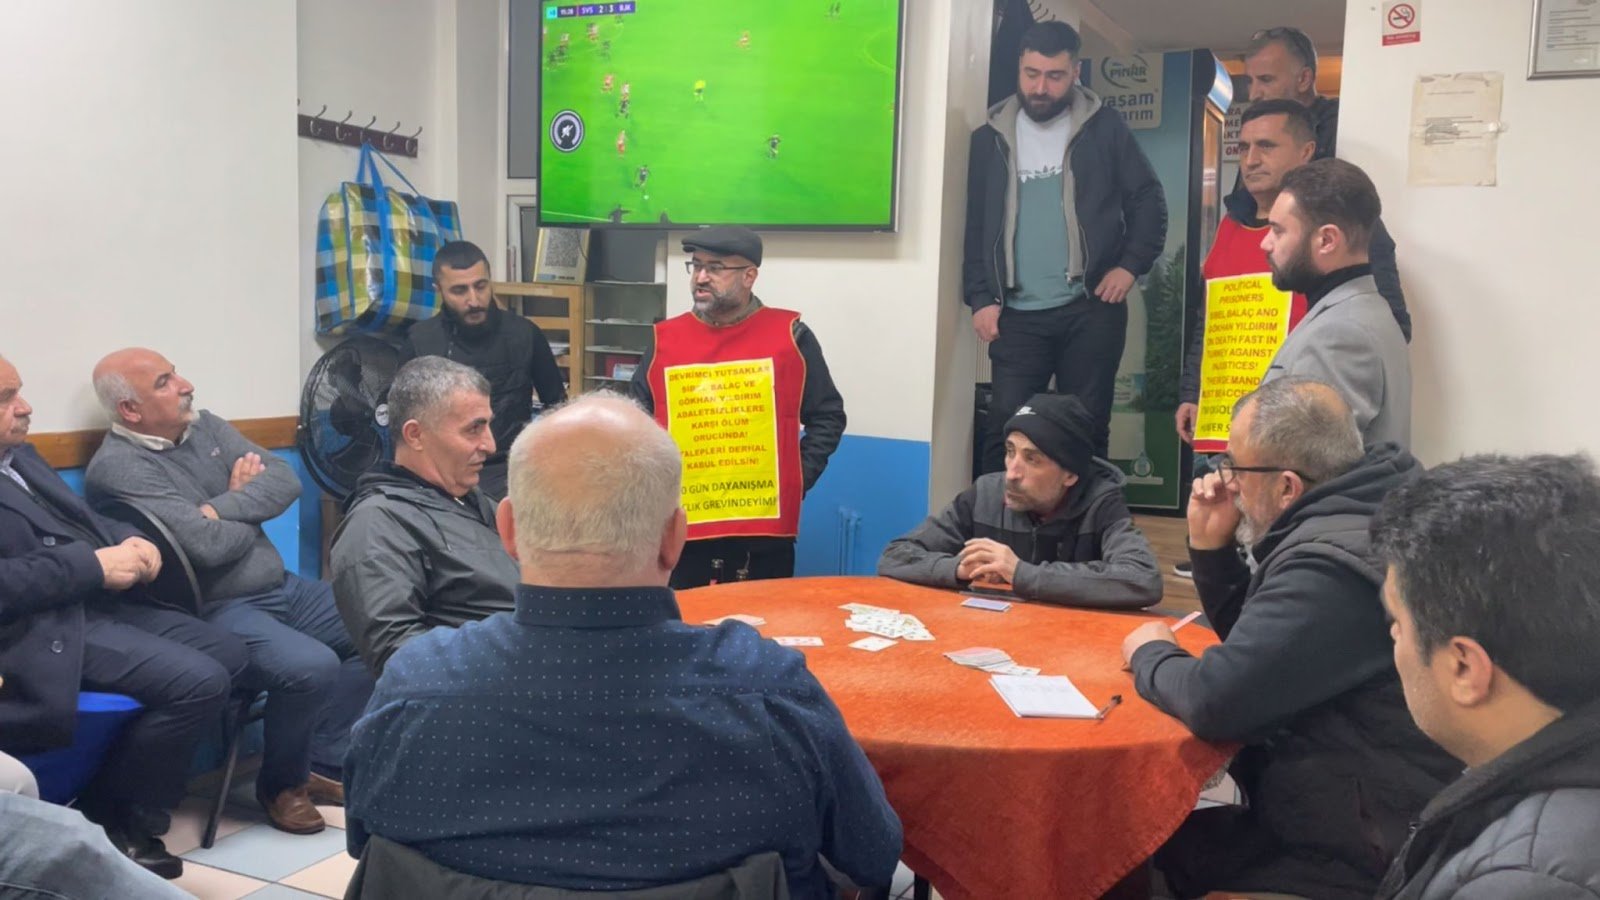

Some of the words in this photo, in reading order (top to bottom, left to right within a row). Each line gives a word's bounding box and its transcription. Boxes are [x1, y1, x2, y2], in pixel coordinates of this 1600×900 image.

[599, 5, 604, 13] 2
[1219, 294, 1264, 304] PRISONERS
[1256, 308, 1278, 317] AND
[1235, 321, 1278, 331] YILDIRIM
[1238, 335, 1264, 344] FAST
[1266, 335, 1278, 344] IN
[1229, 348, 1273, 357] AGAINST
[711, 382, 741, 392] BALAÇ
[679, 396, 716, 406] GÖKHAN
[691, 420, 718, 430] KARŞI
[721, 418, 749, 427] ÖLÜM
[693, 432, 748, 442] ORUCUNDA!
[729, 445, 766, 453] DERHAL
[686, 460, 715, 470] KABUL
[718, 457, 759, 466] EDİLSİN!
[689, 482, 710, 494] GÜN
[712, 480, 775, 492] DAYANIŞMA
